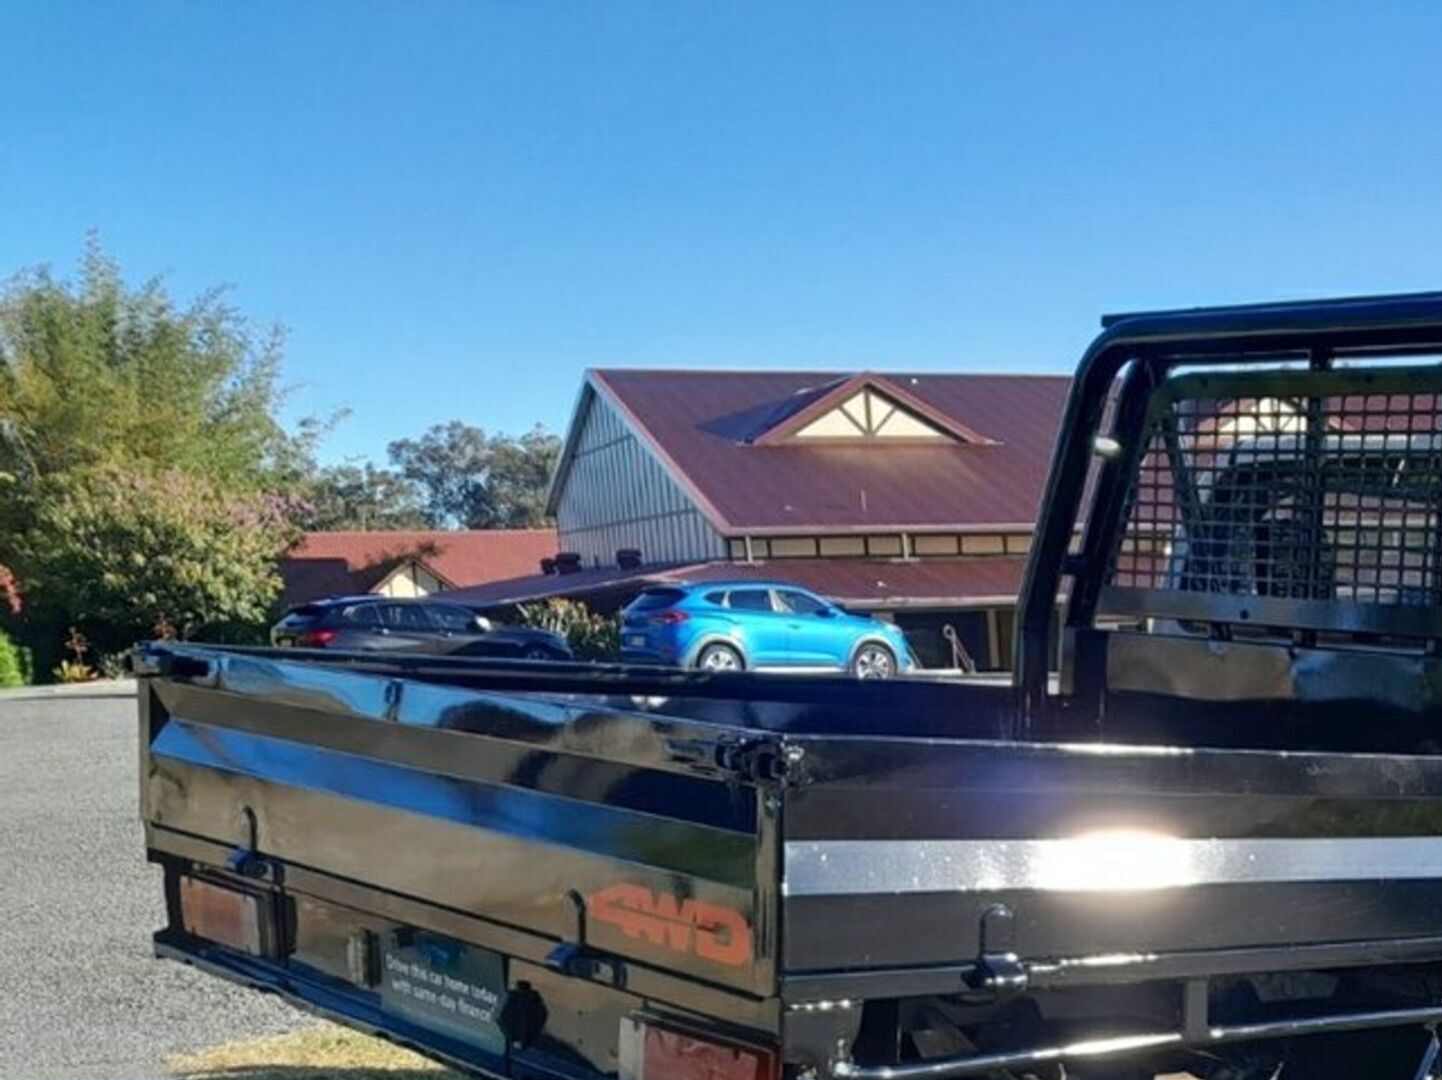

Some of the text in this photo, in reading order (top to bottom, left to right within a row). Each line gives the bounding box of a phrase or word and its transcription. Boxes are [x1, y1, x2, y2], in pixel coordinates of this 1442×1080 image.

[591, 883, 750, 967] 4WD
[386, 953, 409, 976] Drive
[410, 963, 427, 980] this
[428, 971, 443, 987] car
[443, 973, 469, 995] home
[391, 979, 411, 996] with
